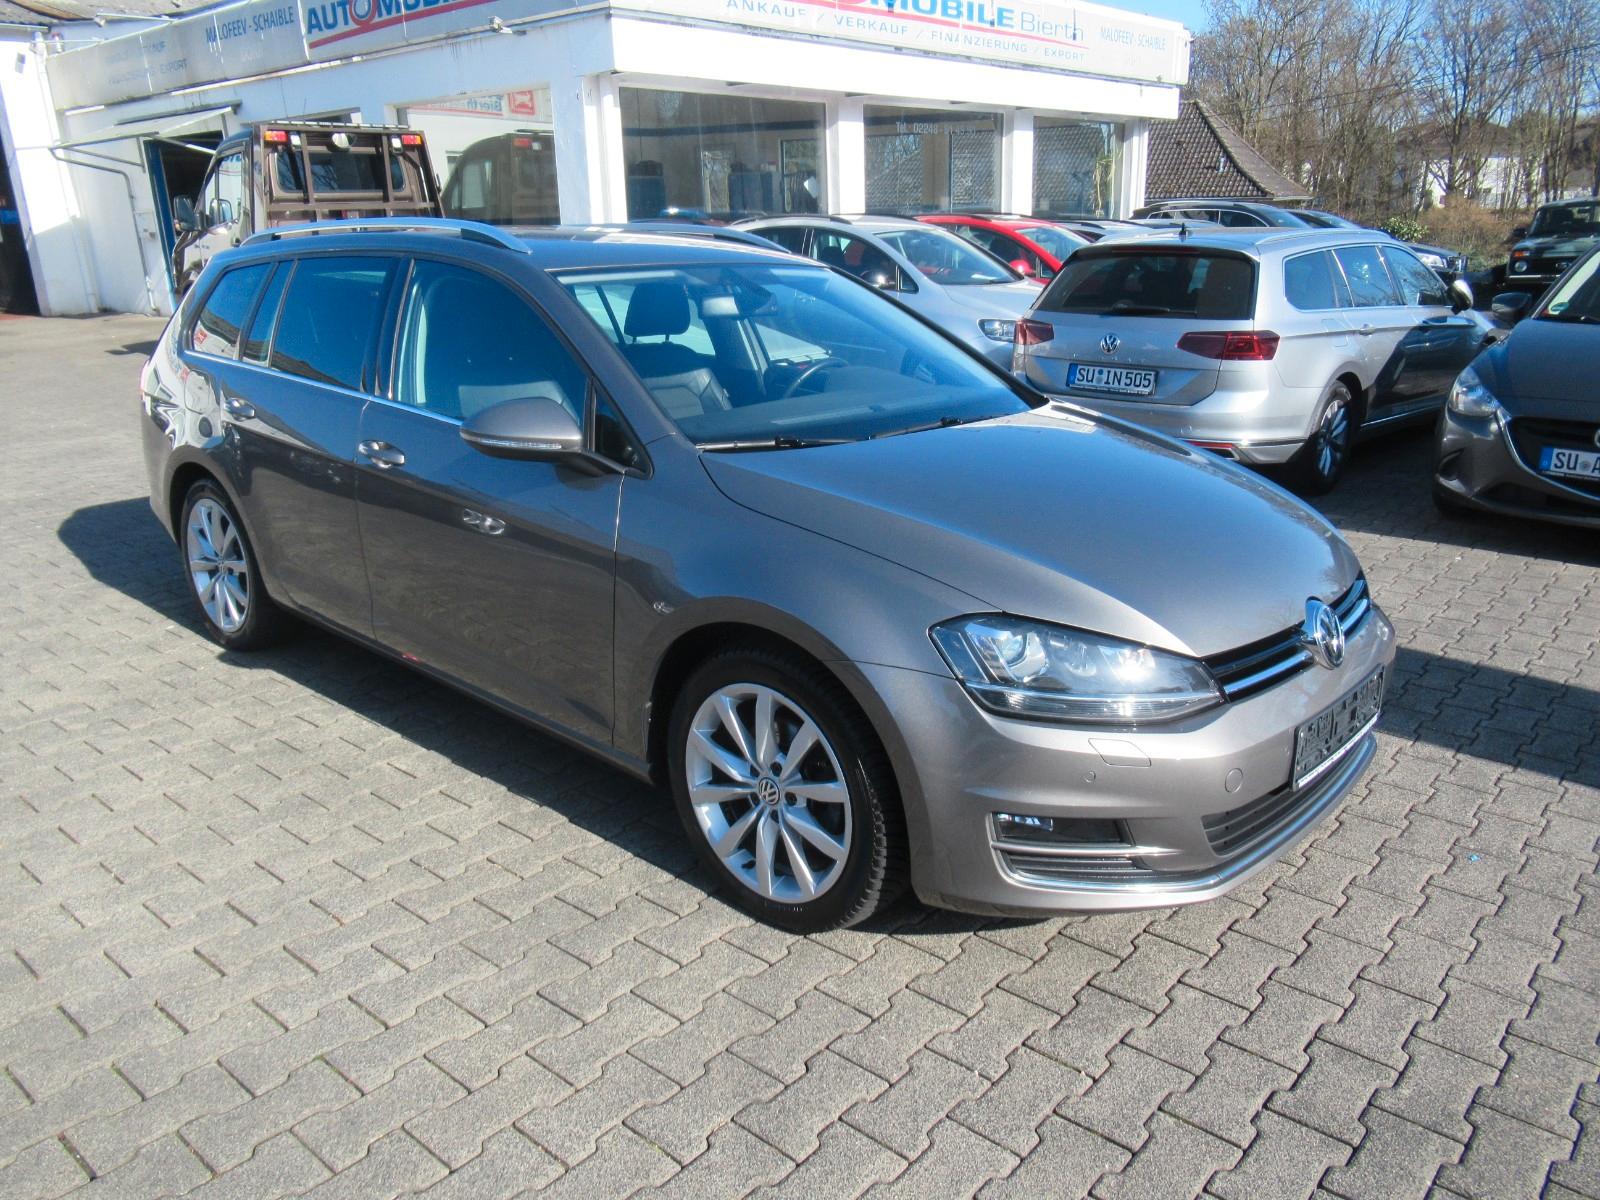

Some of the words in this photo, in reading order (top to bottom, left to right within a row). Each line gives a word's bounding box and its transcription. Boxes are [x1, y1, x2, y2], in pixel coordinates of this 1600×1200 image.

[205, 17, 247, 42] MALOFEEV
[253, 6, 295, 32] SCHAIBLE
[834, 14, 908, 36] VERKAUF
[931, 30, 1028, 53] FINANZIERUNG
[1044, 47, 1085, 62] EXPORT
[1100, 25, 1135, 46] MALOFEEV
[1138, 33, 1166, 50] SCHAIBLE
[1077, 367, 1095, 383] SU
[1553, 452, 1579, 470] SU
